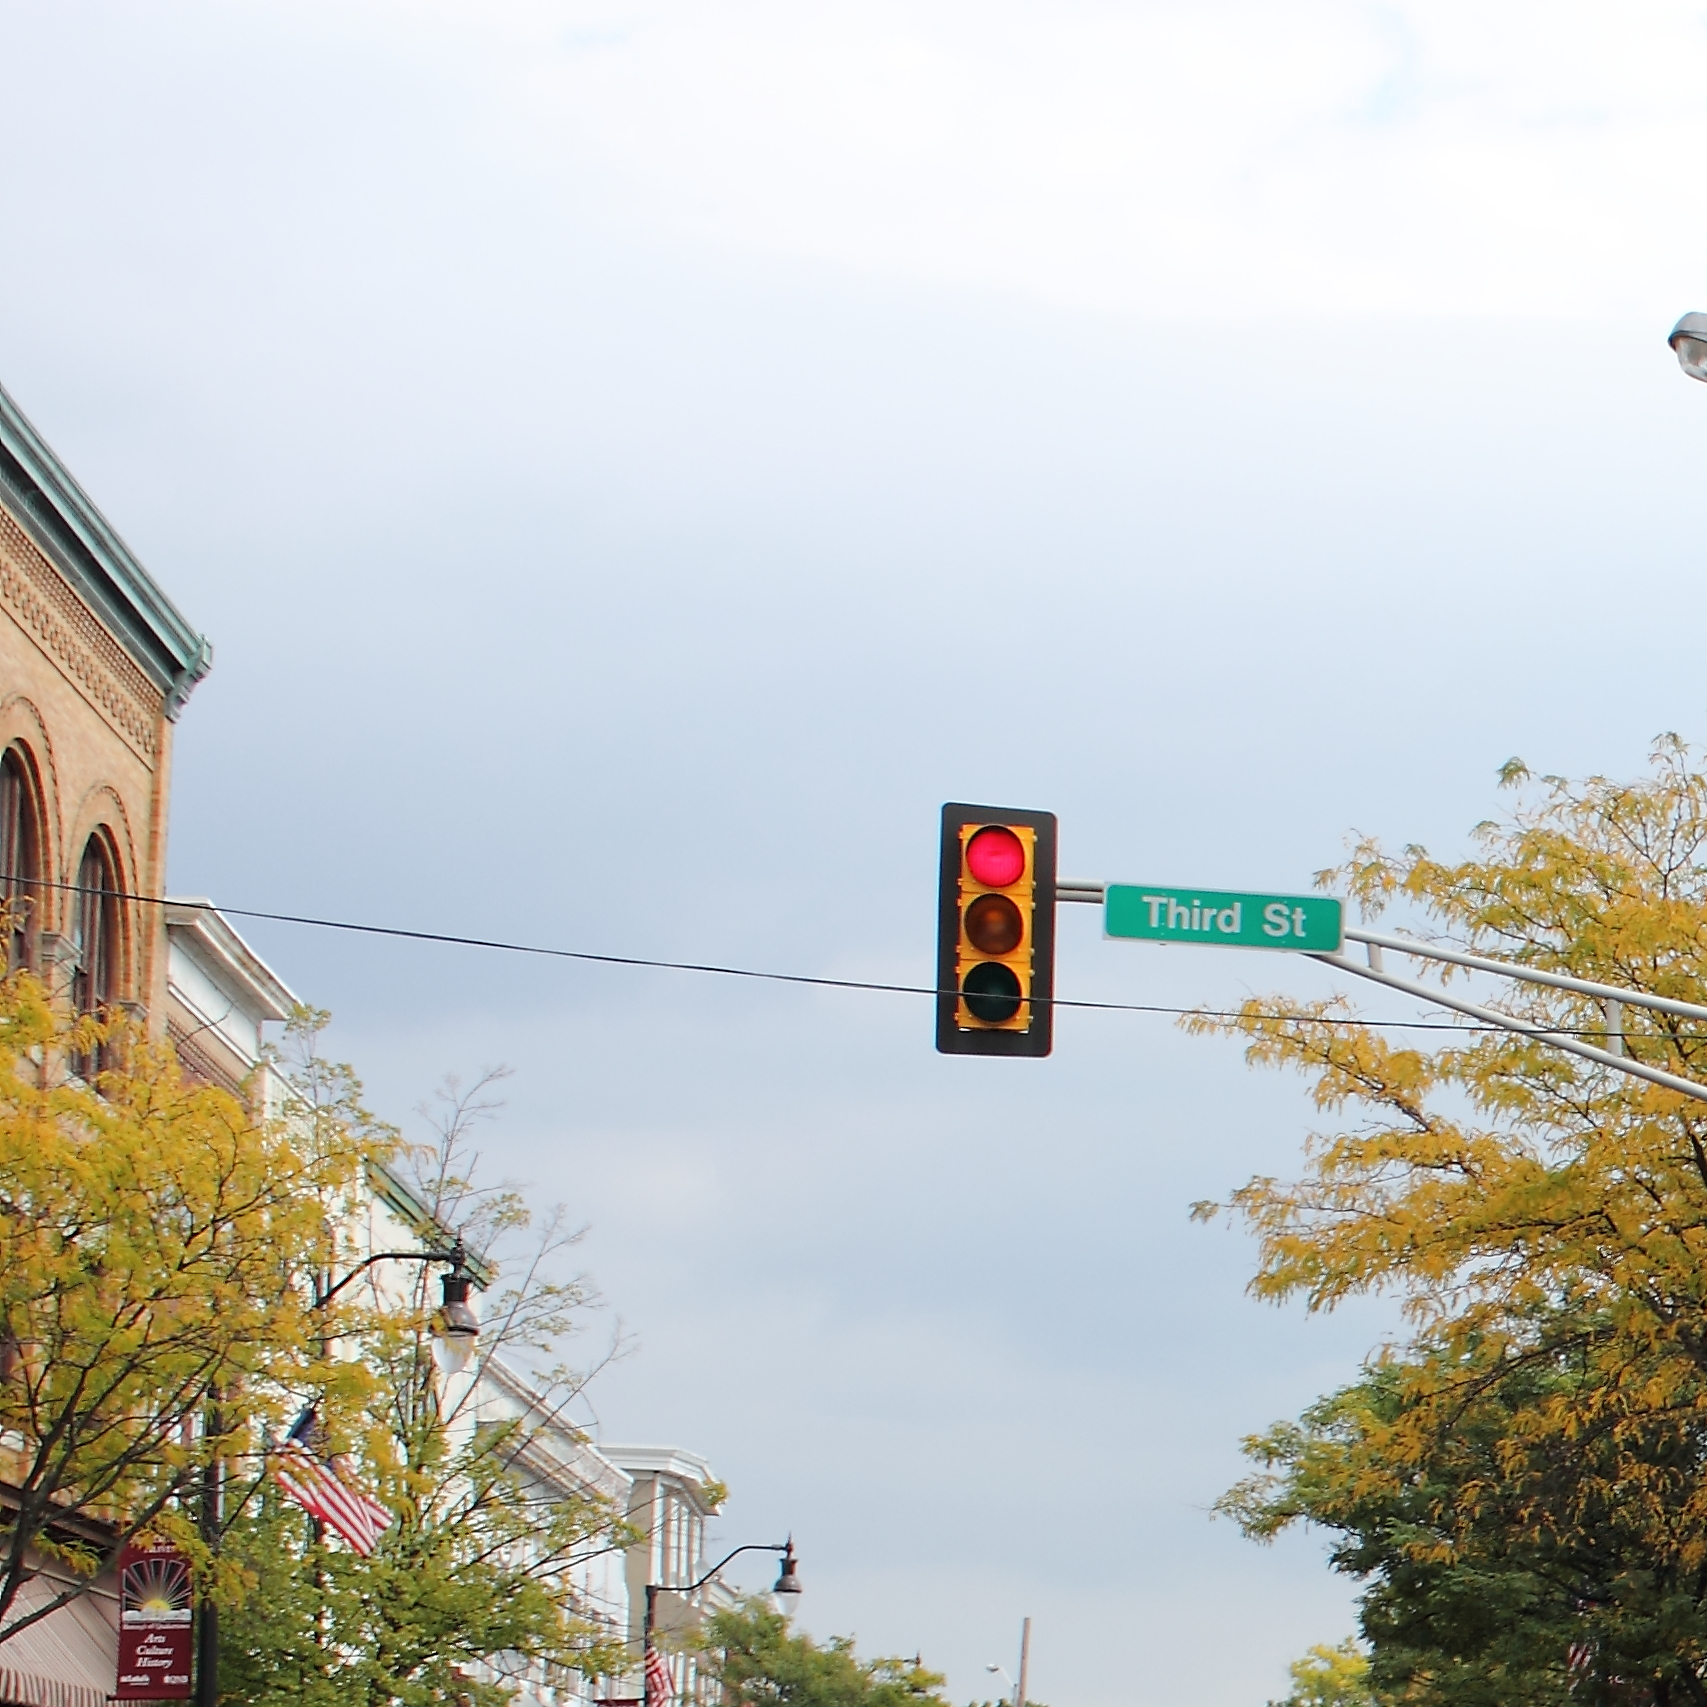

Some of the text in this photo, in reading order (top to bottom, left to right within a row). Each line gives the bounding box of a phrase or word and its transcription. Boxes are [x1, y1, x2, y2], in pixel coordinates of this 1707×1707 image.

[1141, 895, 1307, 938] Third St
[143, 1633, 167, 1643] Arts
[135, 1656, 174, 1668] History
